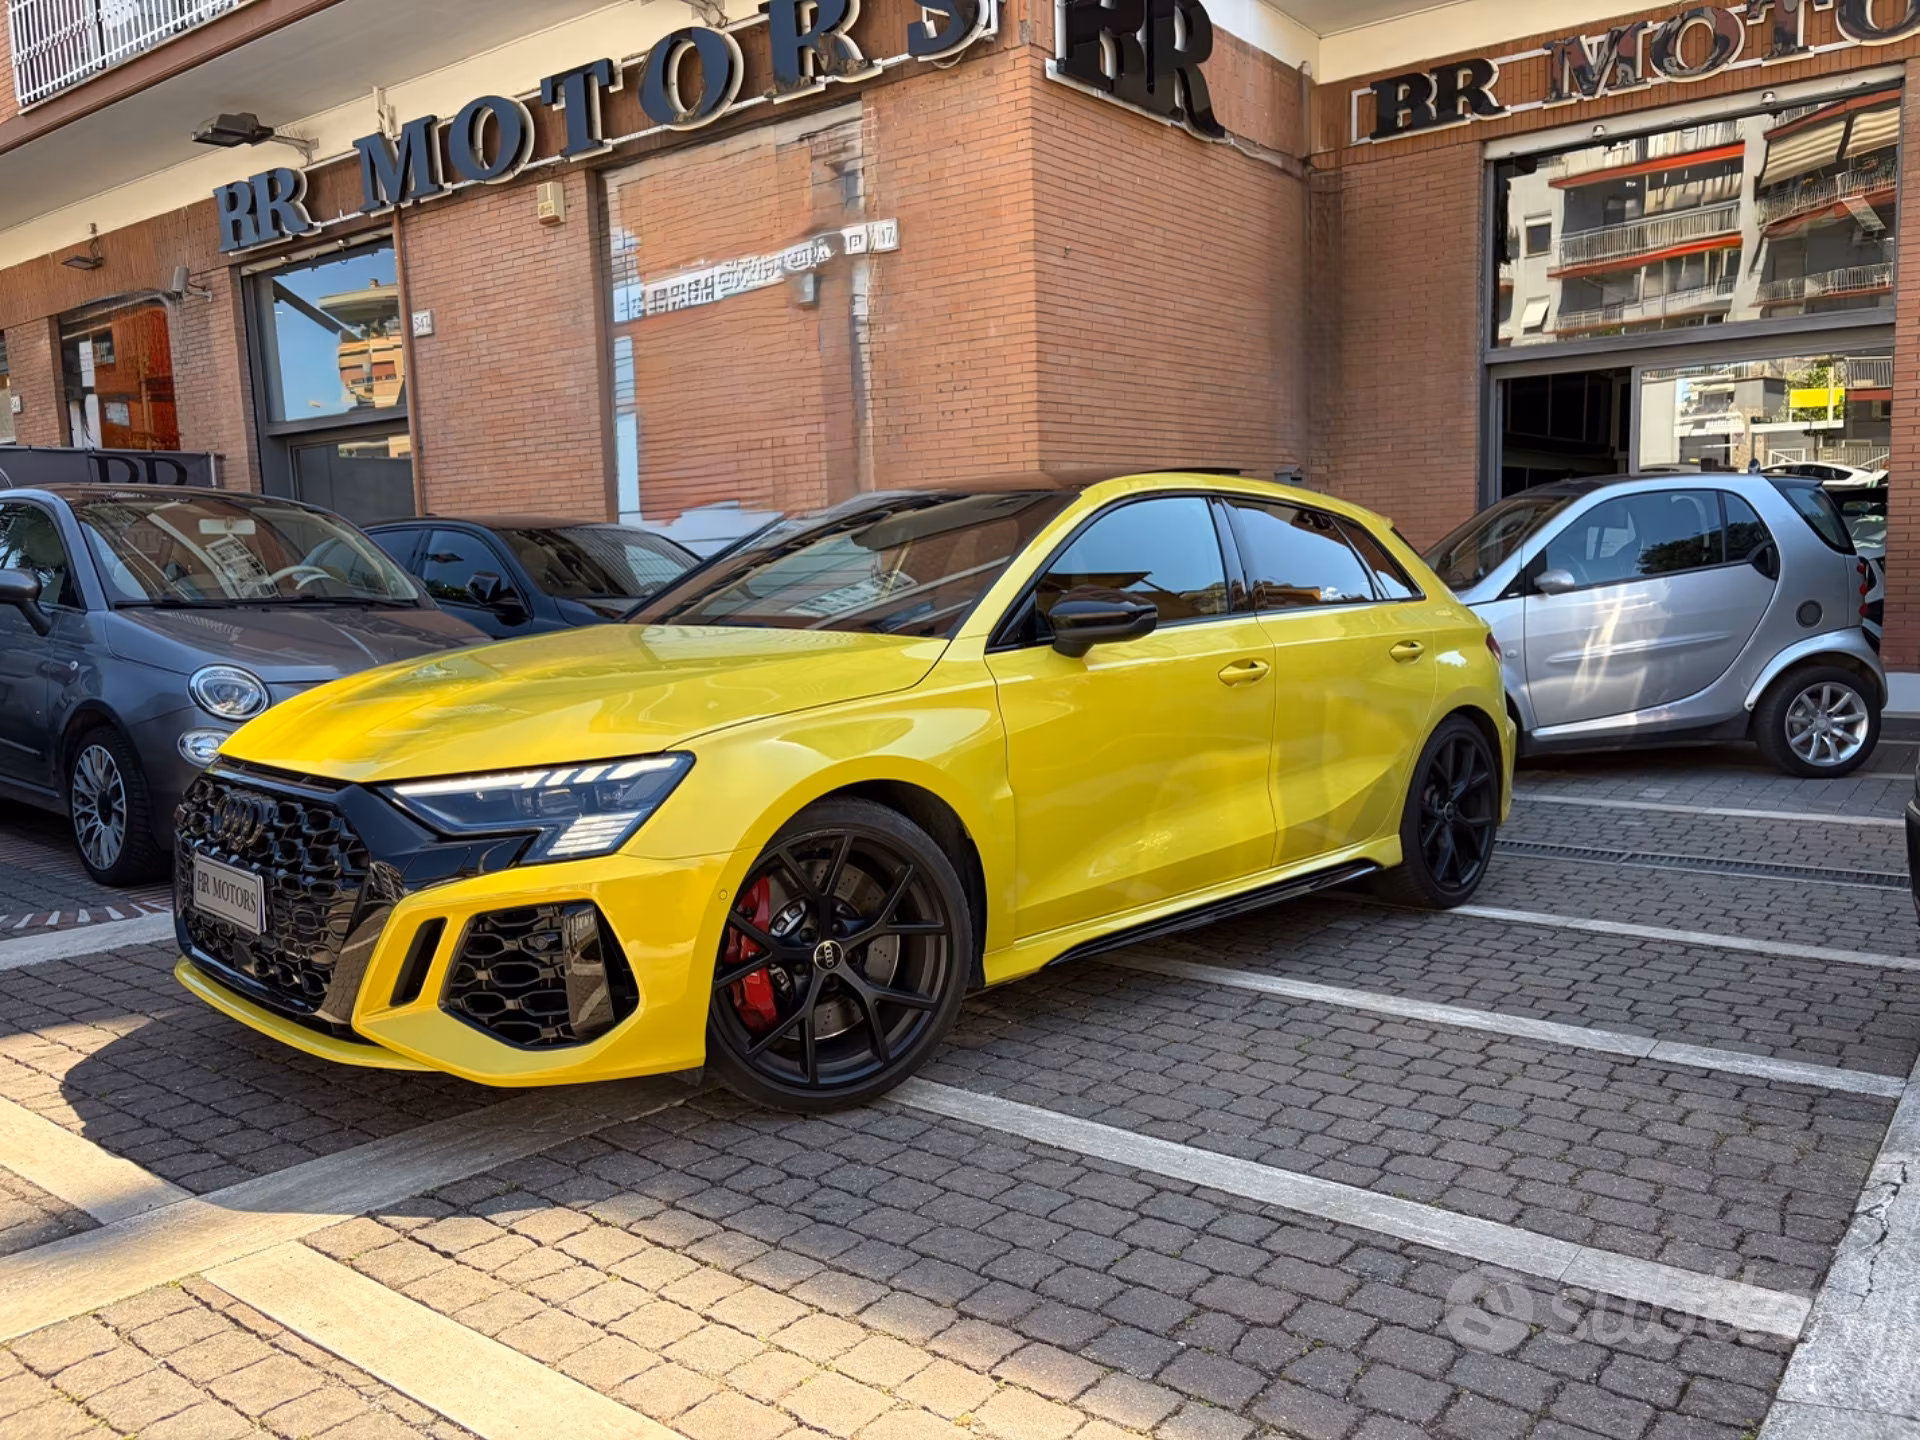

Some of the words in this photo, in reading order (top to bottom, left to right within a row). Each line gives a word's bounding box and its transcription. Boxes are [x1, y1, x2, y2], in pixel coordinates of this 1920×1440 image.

[213, 167, 311, 253] RR
[353, 0, 990, 214] MOTORS
[1370, 57, 1509, 140] RR
[212, 876, 257, 914] MOTORS
